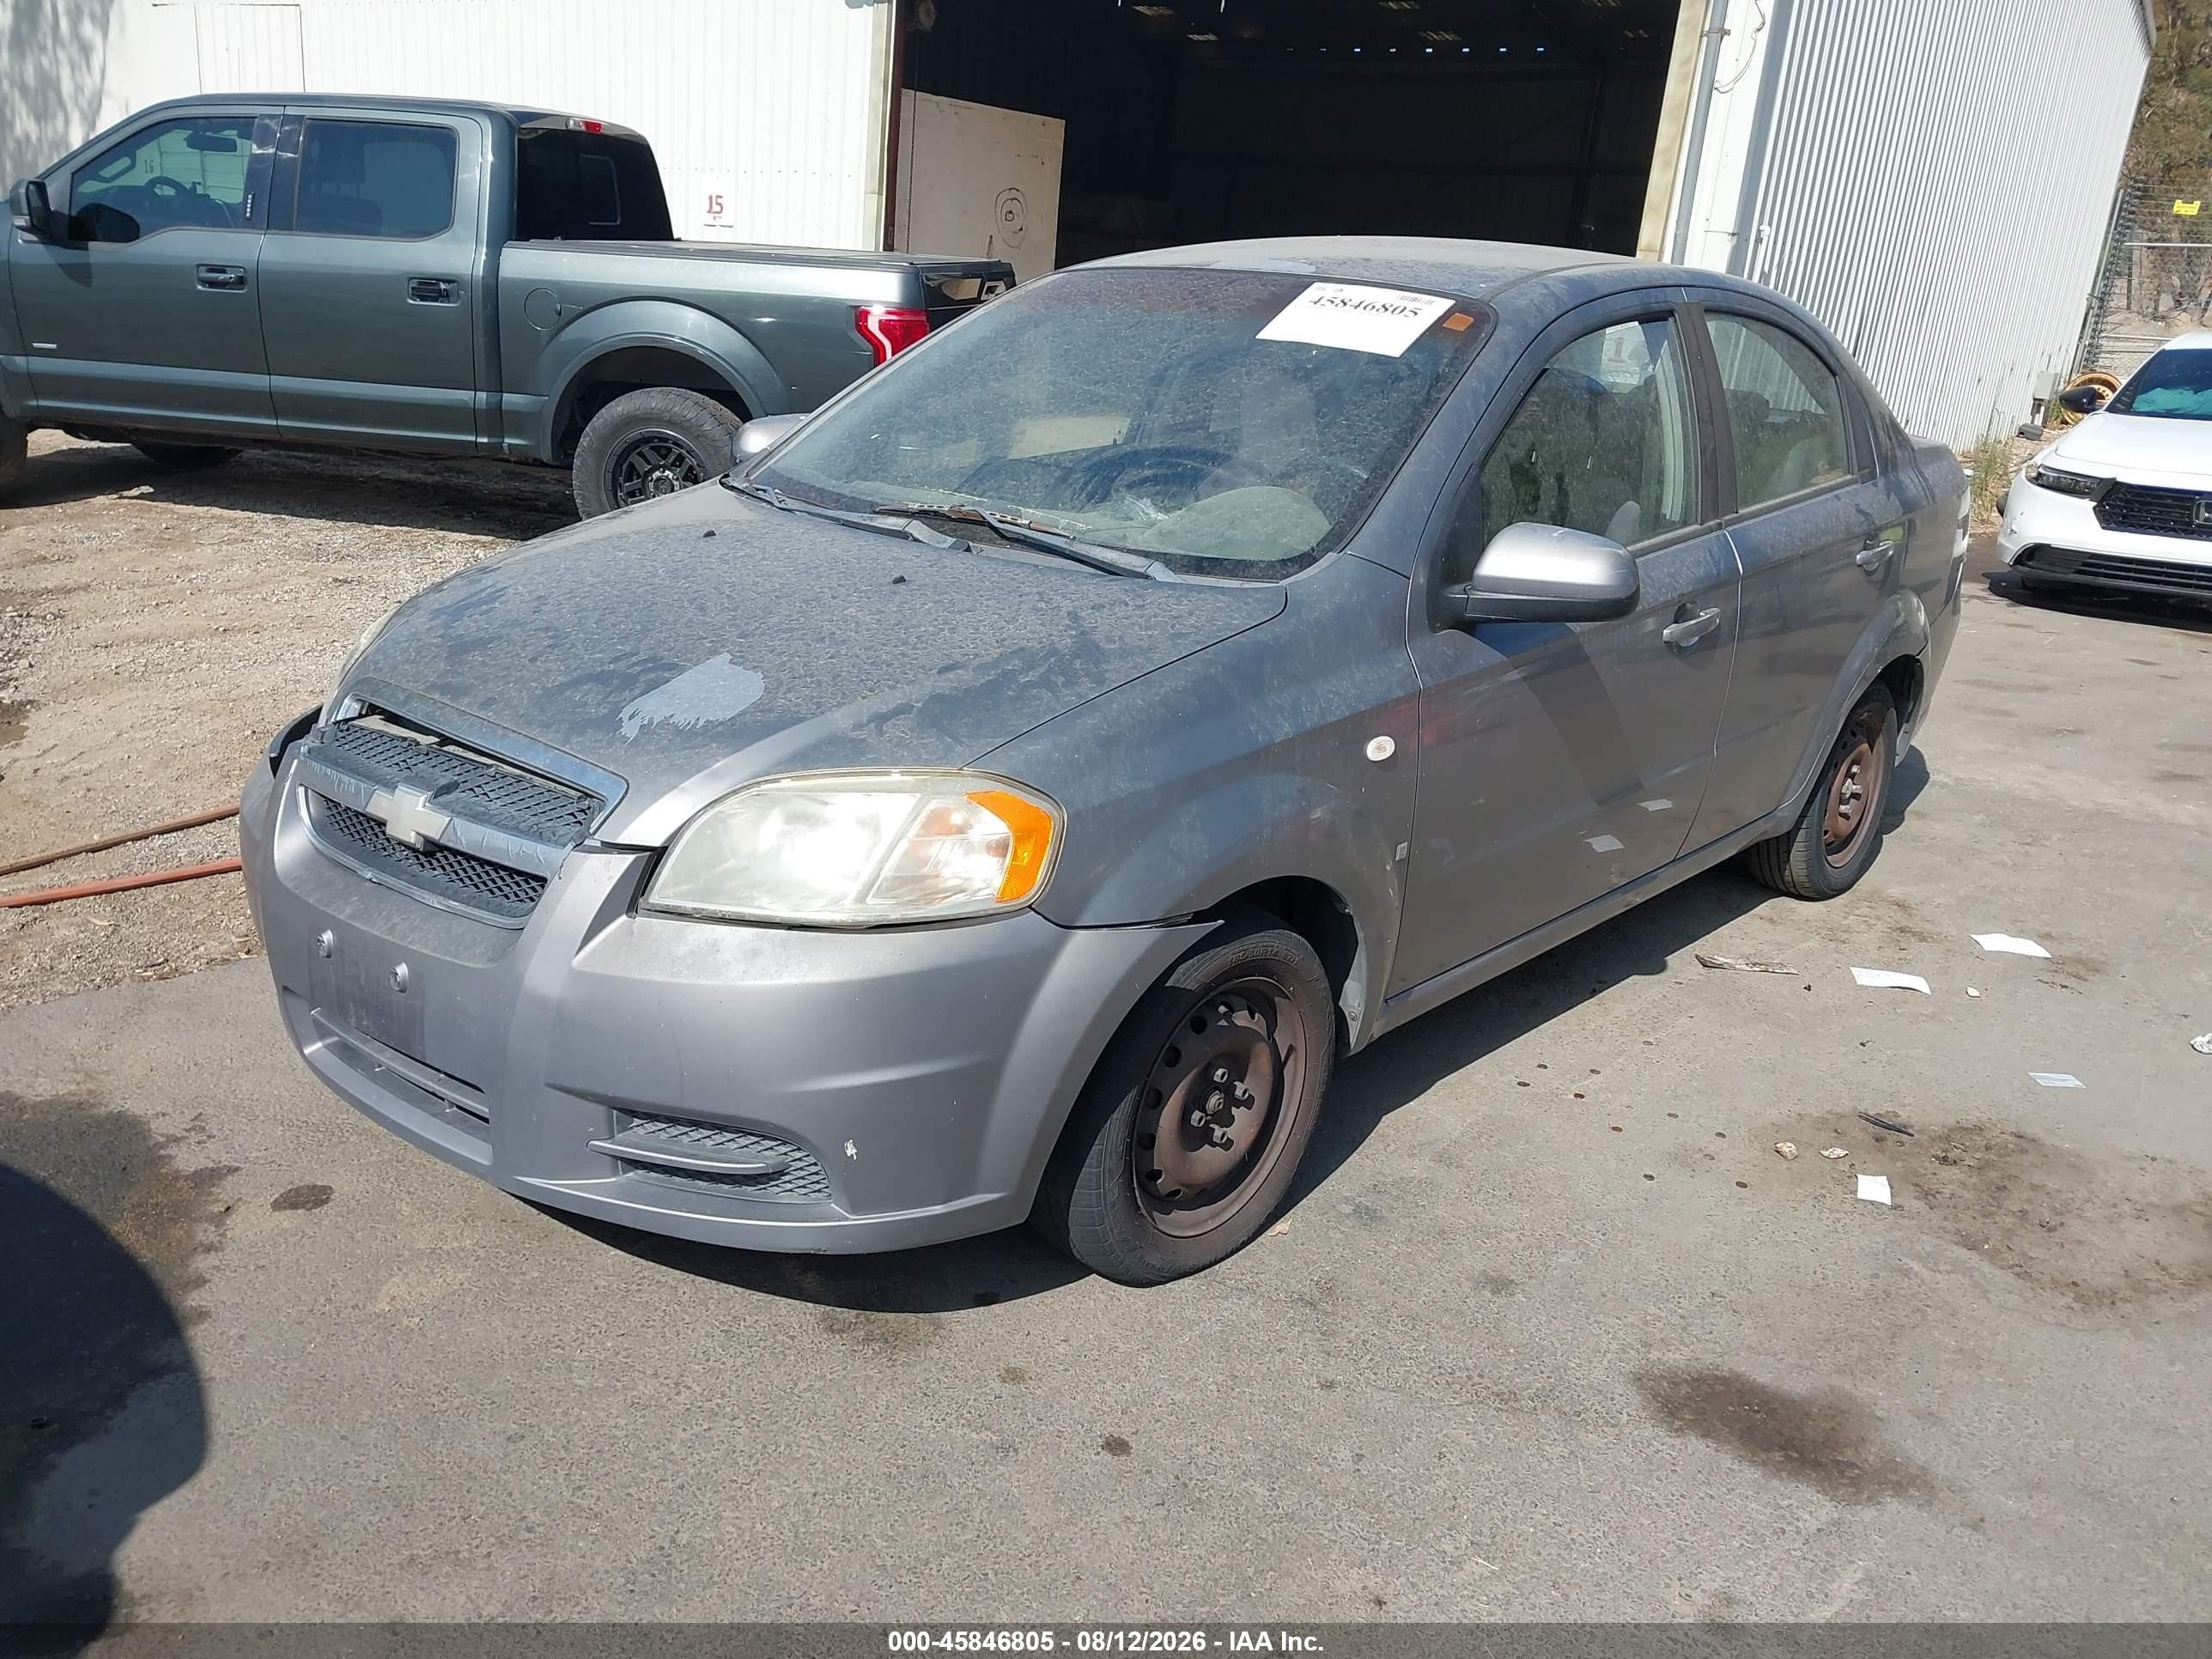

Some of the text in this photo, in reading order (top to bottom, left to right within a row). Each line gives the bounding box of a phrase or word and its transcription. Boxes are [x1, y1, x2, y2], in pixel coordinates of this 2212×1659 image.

[143, 159, 155, 174] 16
[706, 194, 724, 215] 15
[1309, 295, 1423, 319] 45846805
